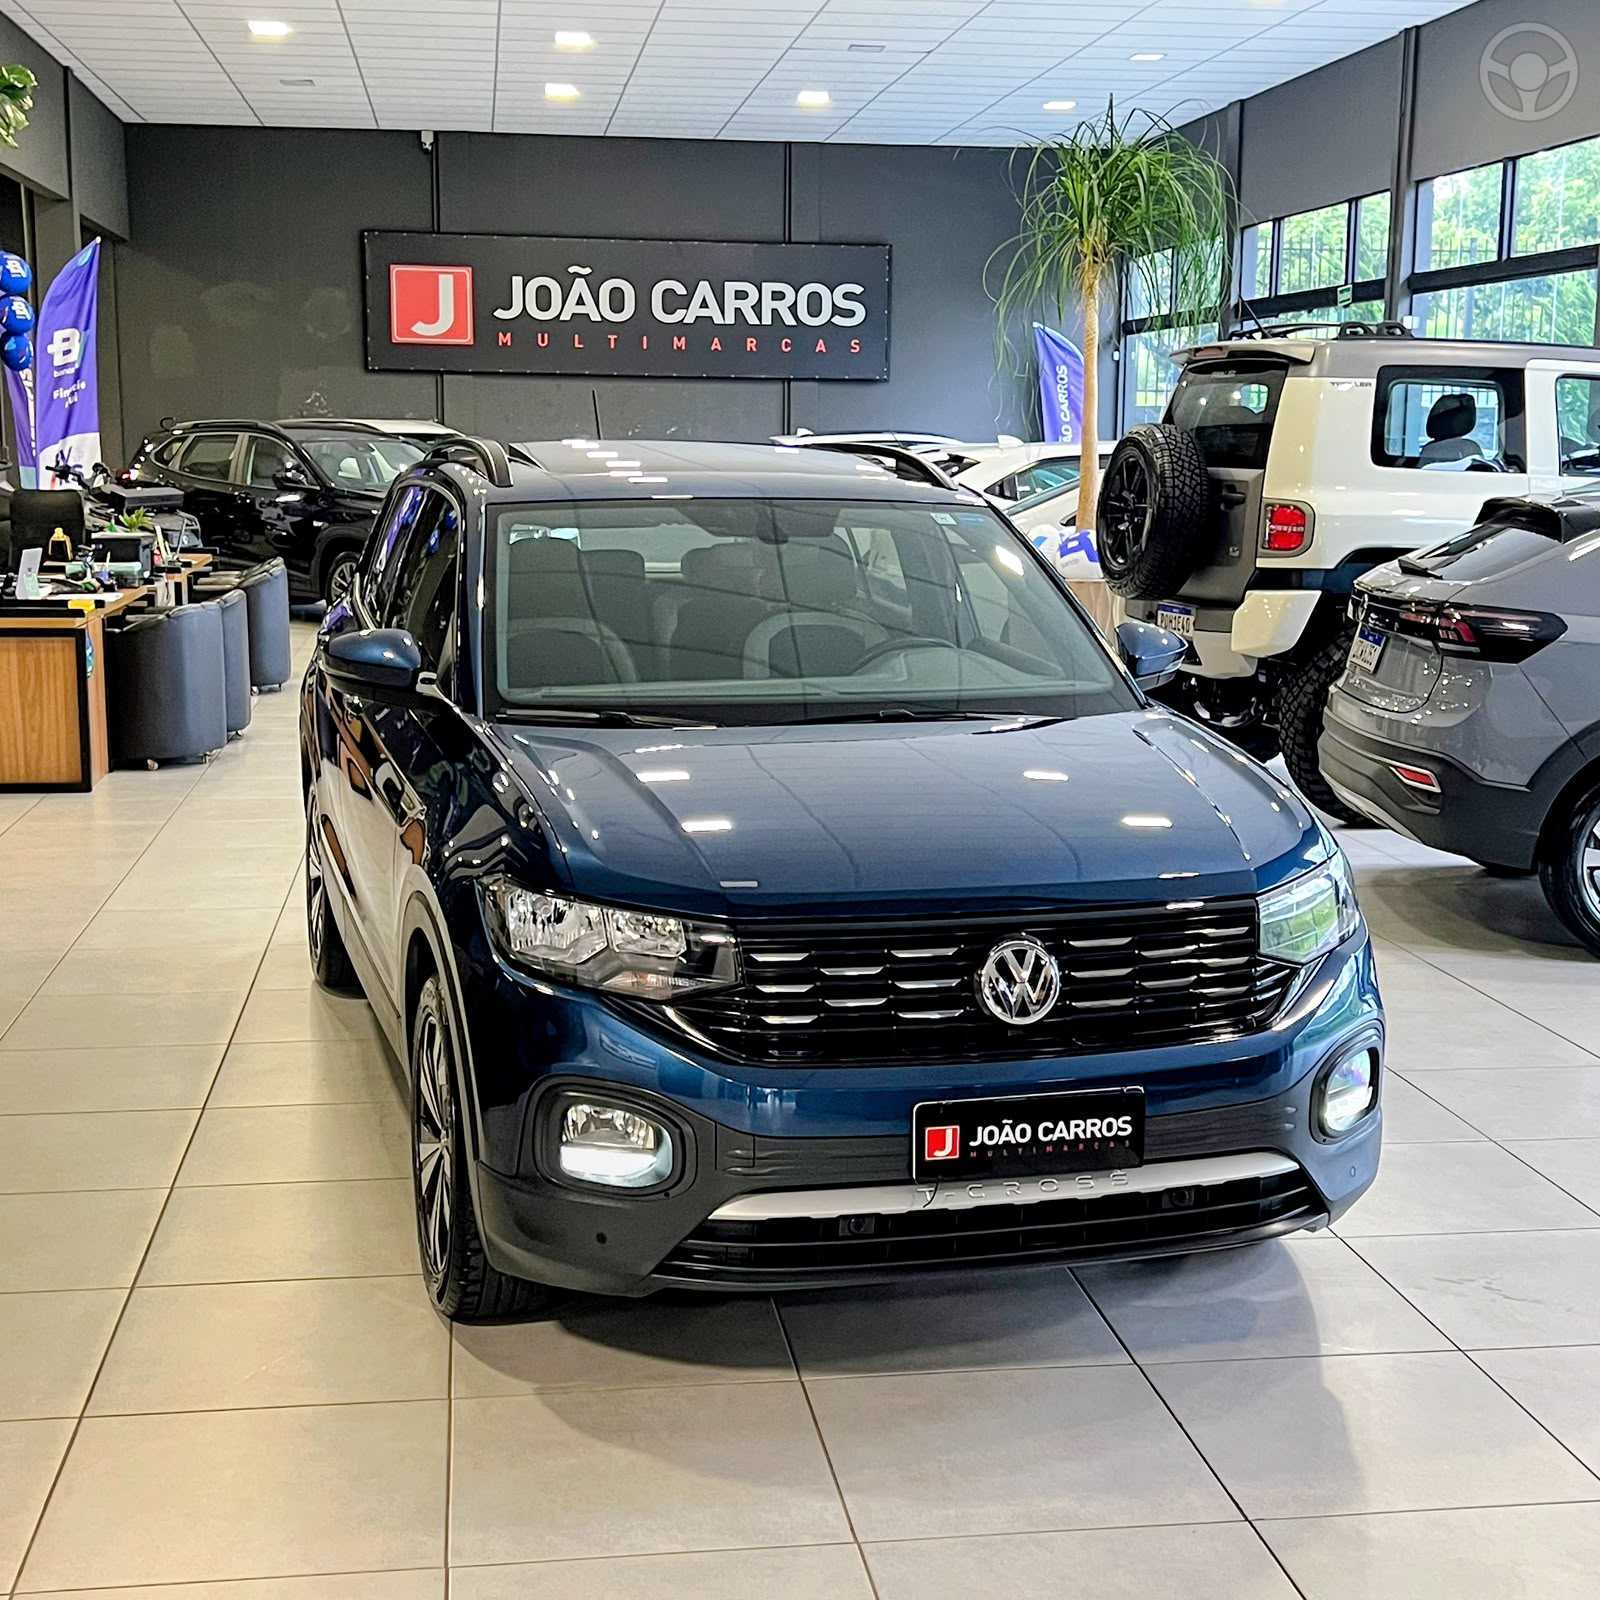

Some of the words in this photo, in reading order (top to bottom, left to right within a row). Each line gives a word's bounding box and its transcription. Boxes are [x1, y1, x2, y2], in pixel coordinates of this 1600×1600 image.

[412, 272, 455, 337] J
[492, 264, 636, 323] JOÃO
[651, 279, 867, 328] CARROS
[497, 332, 861, 353] MULTIMARCAS
[1055, 364, 1071, 422] CARROS
[933, 1128, 953, 1157] J
[968, 1119, 1032, 1147] JOÃO
[1037, 1115, 1133, 1142] CARROS
[916, 1170, 1129, 1203] T-CROSS
